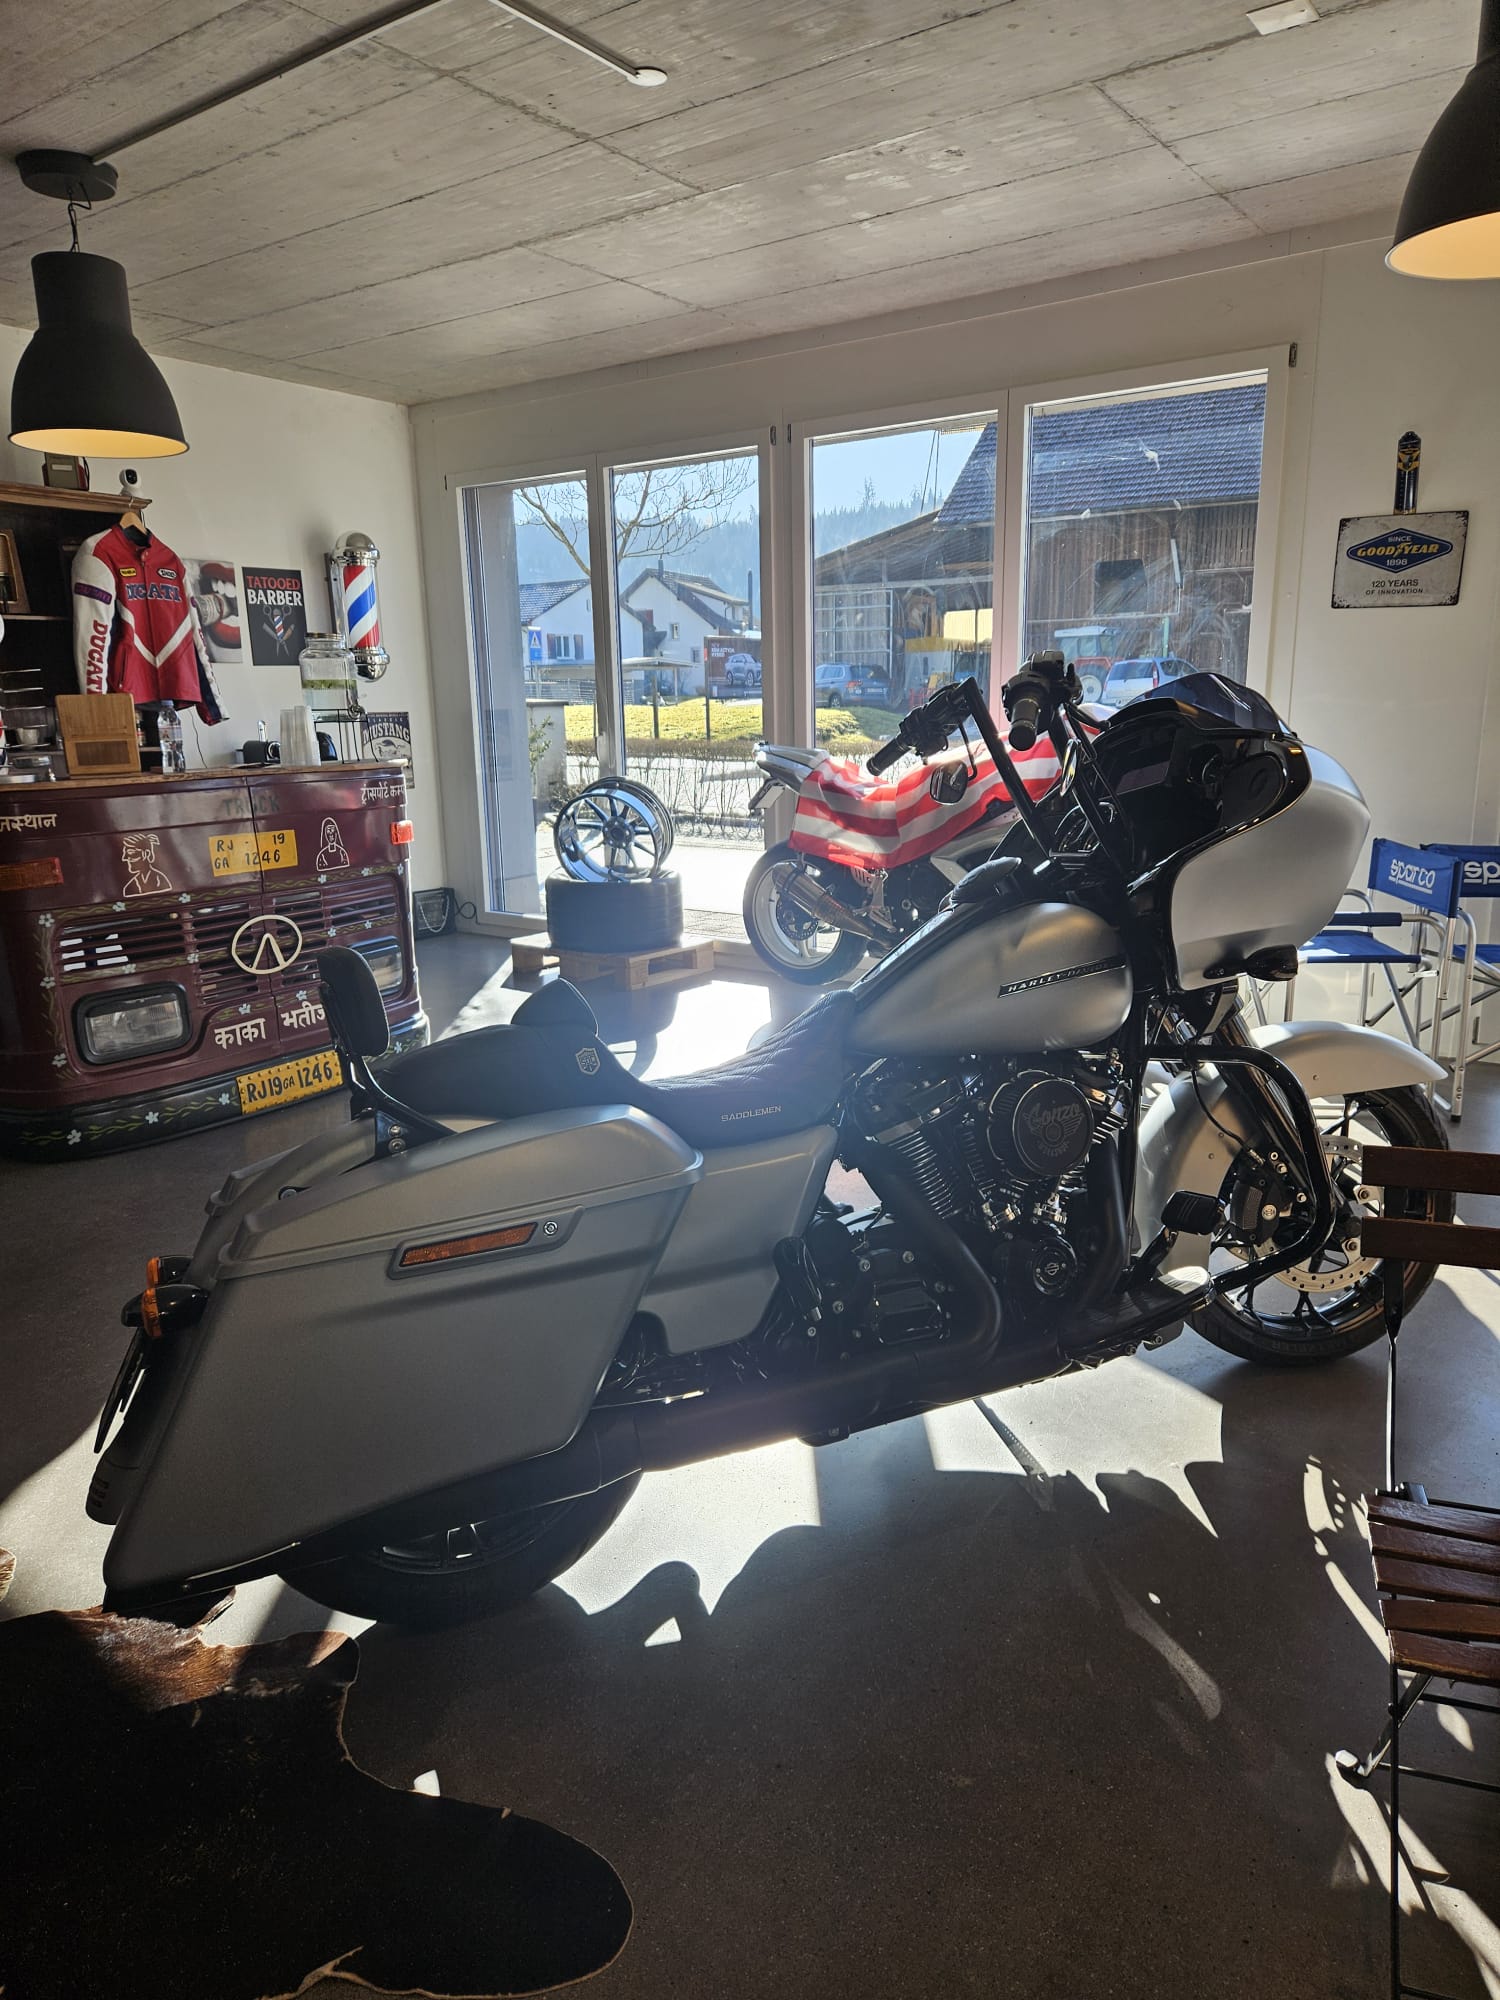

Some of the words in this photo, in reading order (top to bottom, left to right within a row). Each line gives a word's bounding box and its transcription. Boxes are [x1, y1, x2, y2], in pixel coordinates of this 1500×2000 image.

[1387, 535, 1412, 543] SINCE
[1386, 558, 1408, 567] 1898
[246, 575, 301, 591] TATOOED
[1371, 580, 1386, 589] 120
[1387, 578, 1419, 588] YEARS
[247, 589, 303, 606] BARBER
[1378, 588, 1423, 596] INNOVATION
[362, 722, 410, 745] MUSTANG
[216, 839, 234, 852] RJ
[272, 833, 285, 845] 19
[214, 857, 230, 869] GA
[245, 849, 281, 865] 1246
[1390, 859, 1436, 889] sparco
[214, 1017, 266, 1049] काका
[297, 1061, 333, 1089] 1246
[721, 1105, 782, 1121] SADDLEMEN
